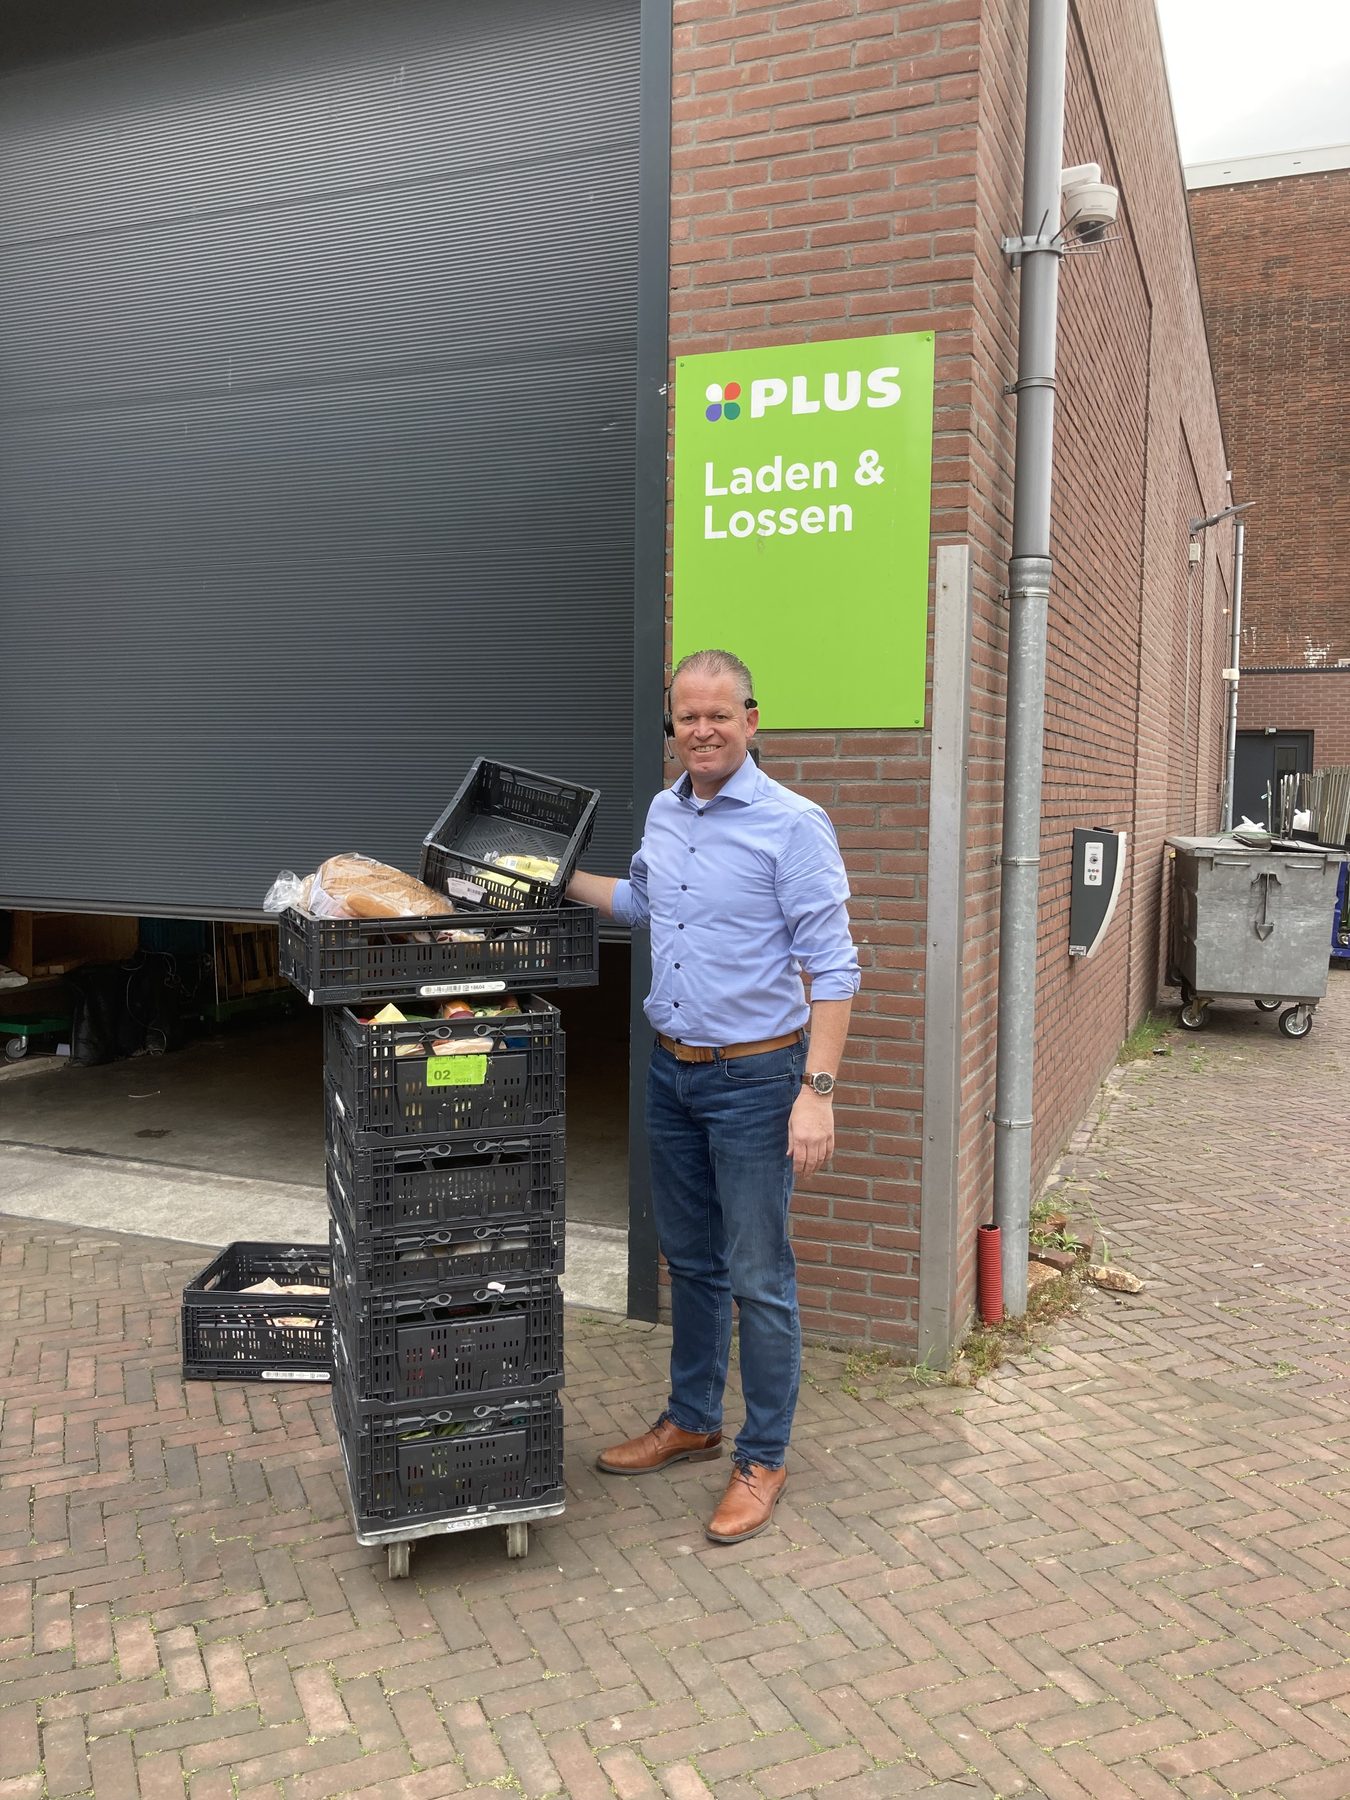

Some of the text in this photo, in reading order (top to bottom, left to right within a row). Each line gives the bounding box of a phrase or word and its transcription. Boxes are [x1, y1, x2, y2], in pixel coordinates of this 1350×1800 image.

[750, 366, 902, 419] PLUS
[704, 449, 885, 497] Laden &
[704, 503, 853, 540] Lossen
[433, 1069, 451, 1080] 02
